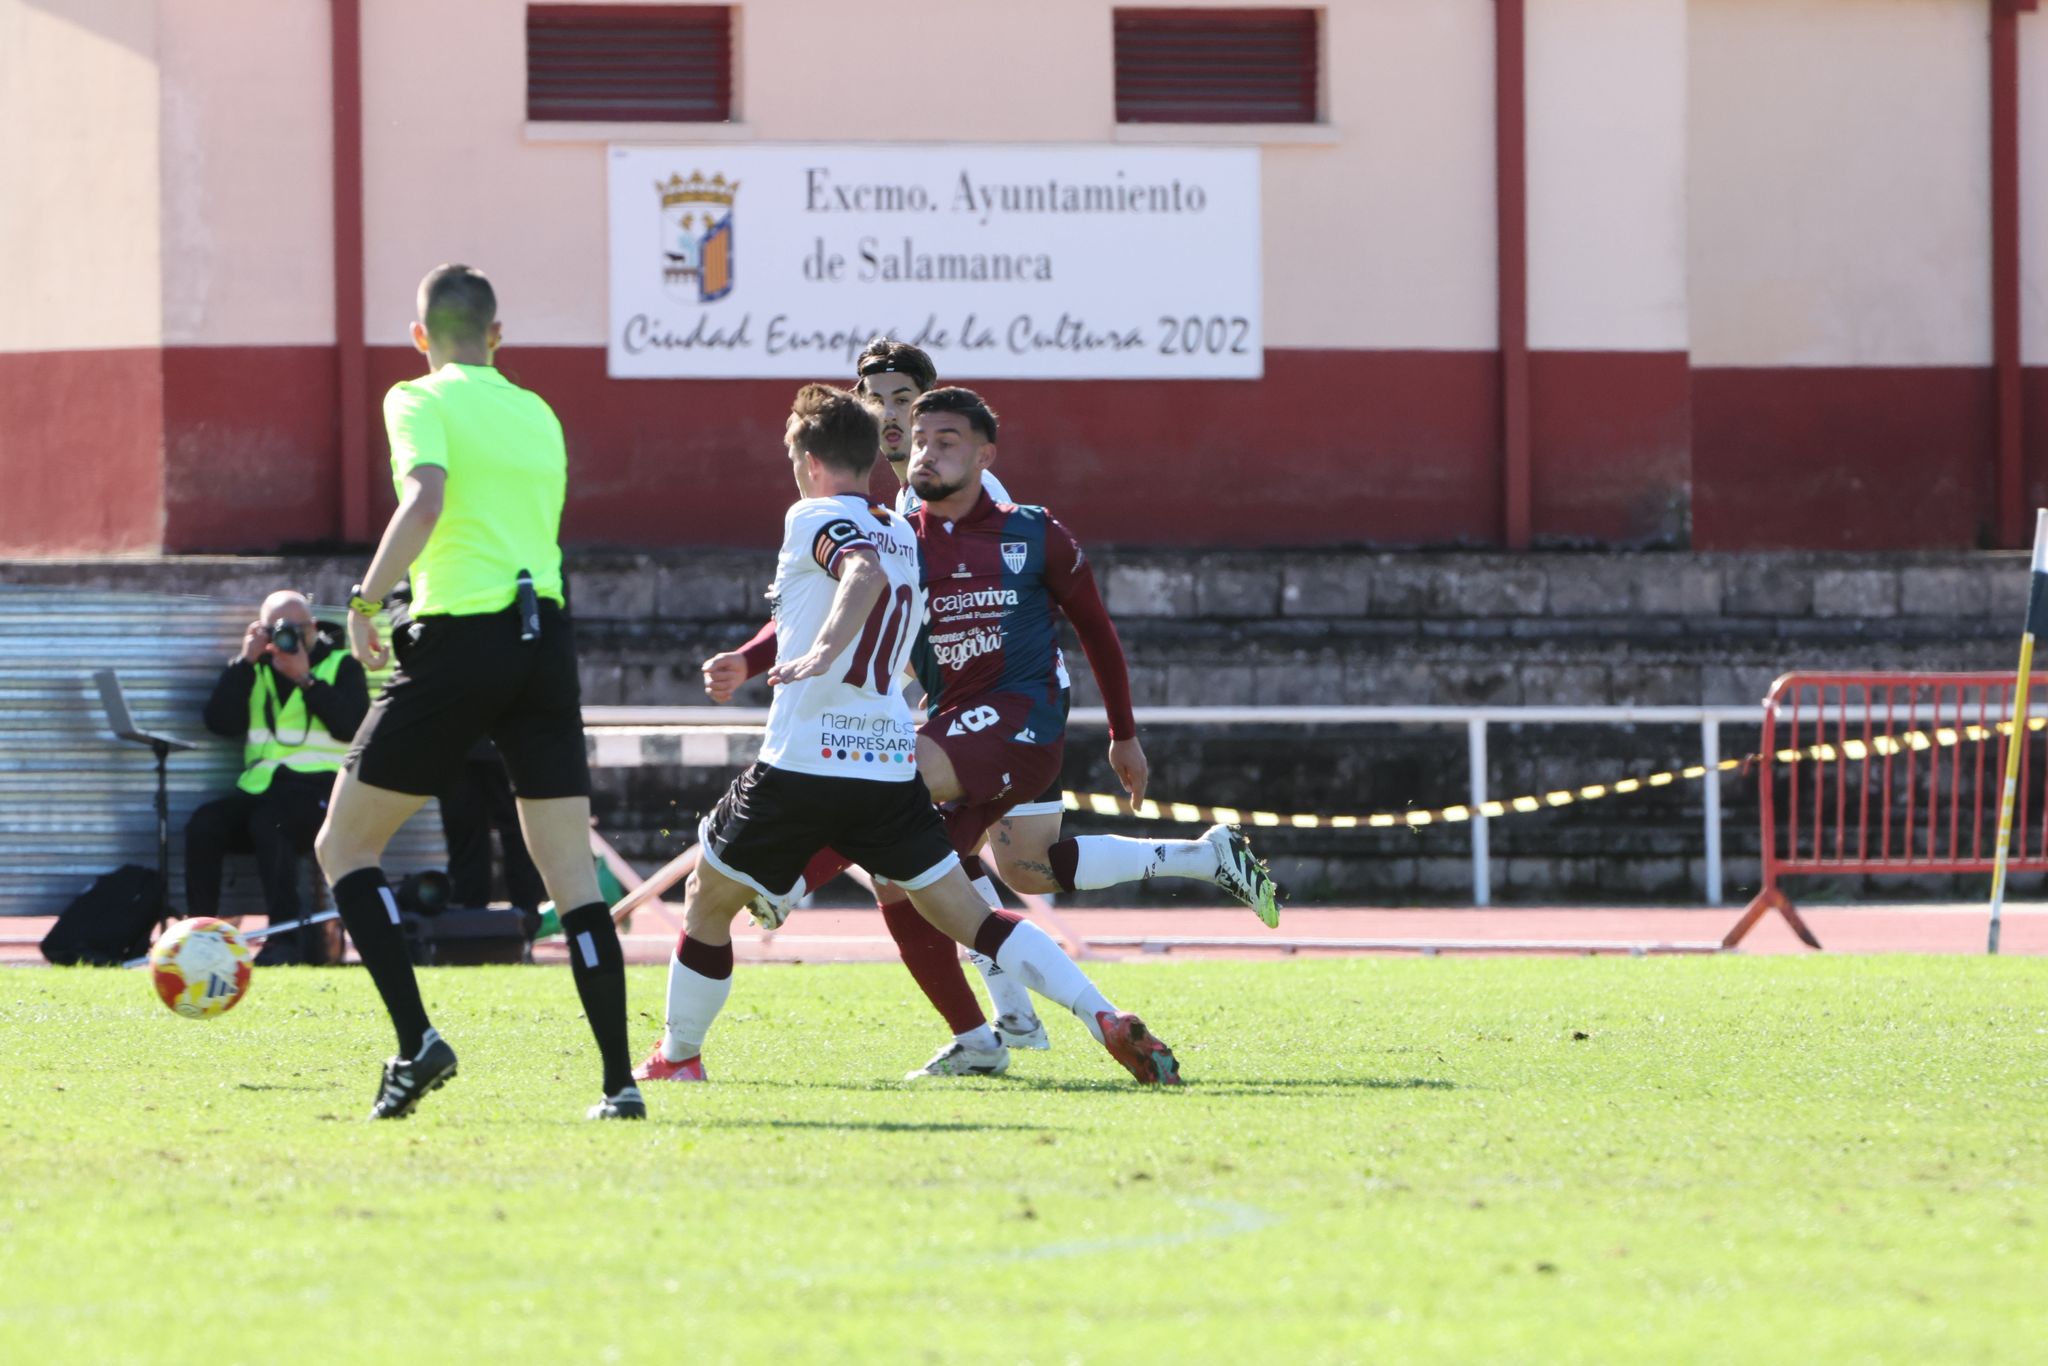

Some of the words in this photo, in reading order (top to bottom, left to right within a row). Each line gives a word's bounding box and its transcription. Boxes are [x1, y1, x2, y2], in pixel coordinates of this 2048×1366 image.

[803, 167, 938, 213] Excmo.
[952, 169, 1208, 225] Ayuntamiento
[803, 236, 846, 283] de
[857, 236, 1054, 283] Salamanca
[622, 313, 752, 355] Ciudad
[960, 312, 996, 350] la
[1006, 311, 1147, 355] Cultura
[1158, 315, 1250, 355] 2002
[828, 522, 857, 541] C
[932, 586, 1018, 613] cajaviva
[841, 582, 913, 696] 10
[933, 630, 1002, 670] segovia
[821, 713, 867, 731] nani
